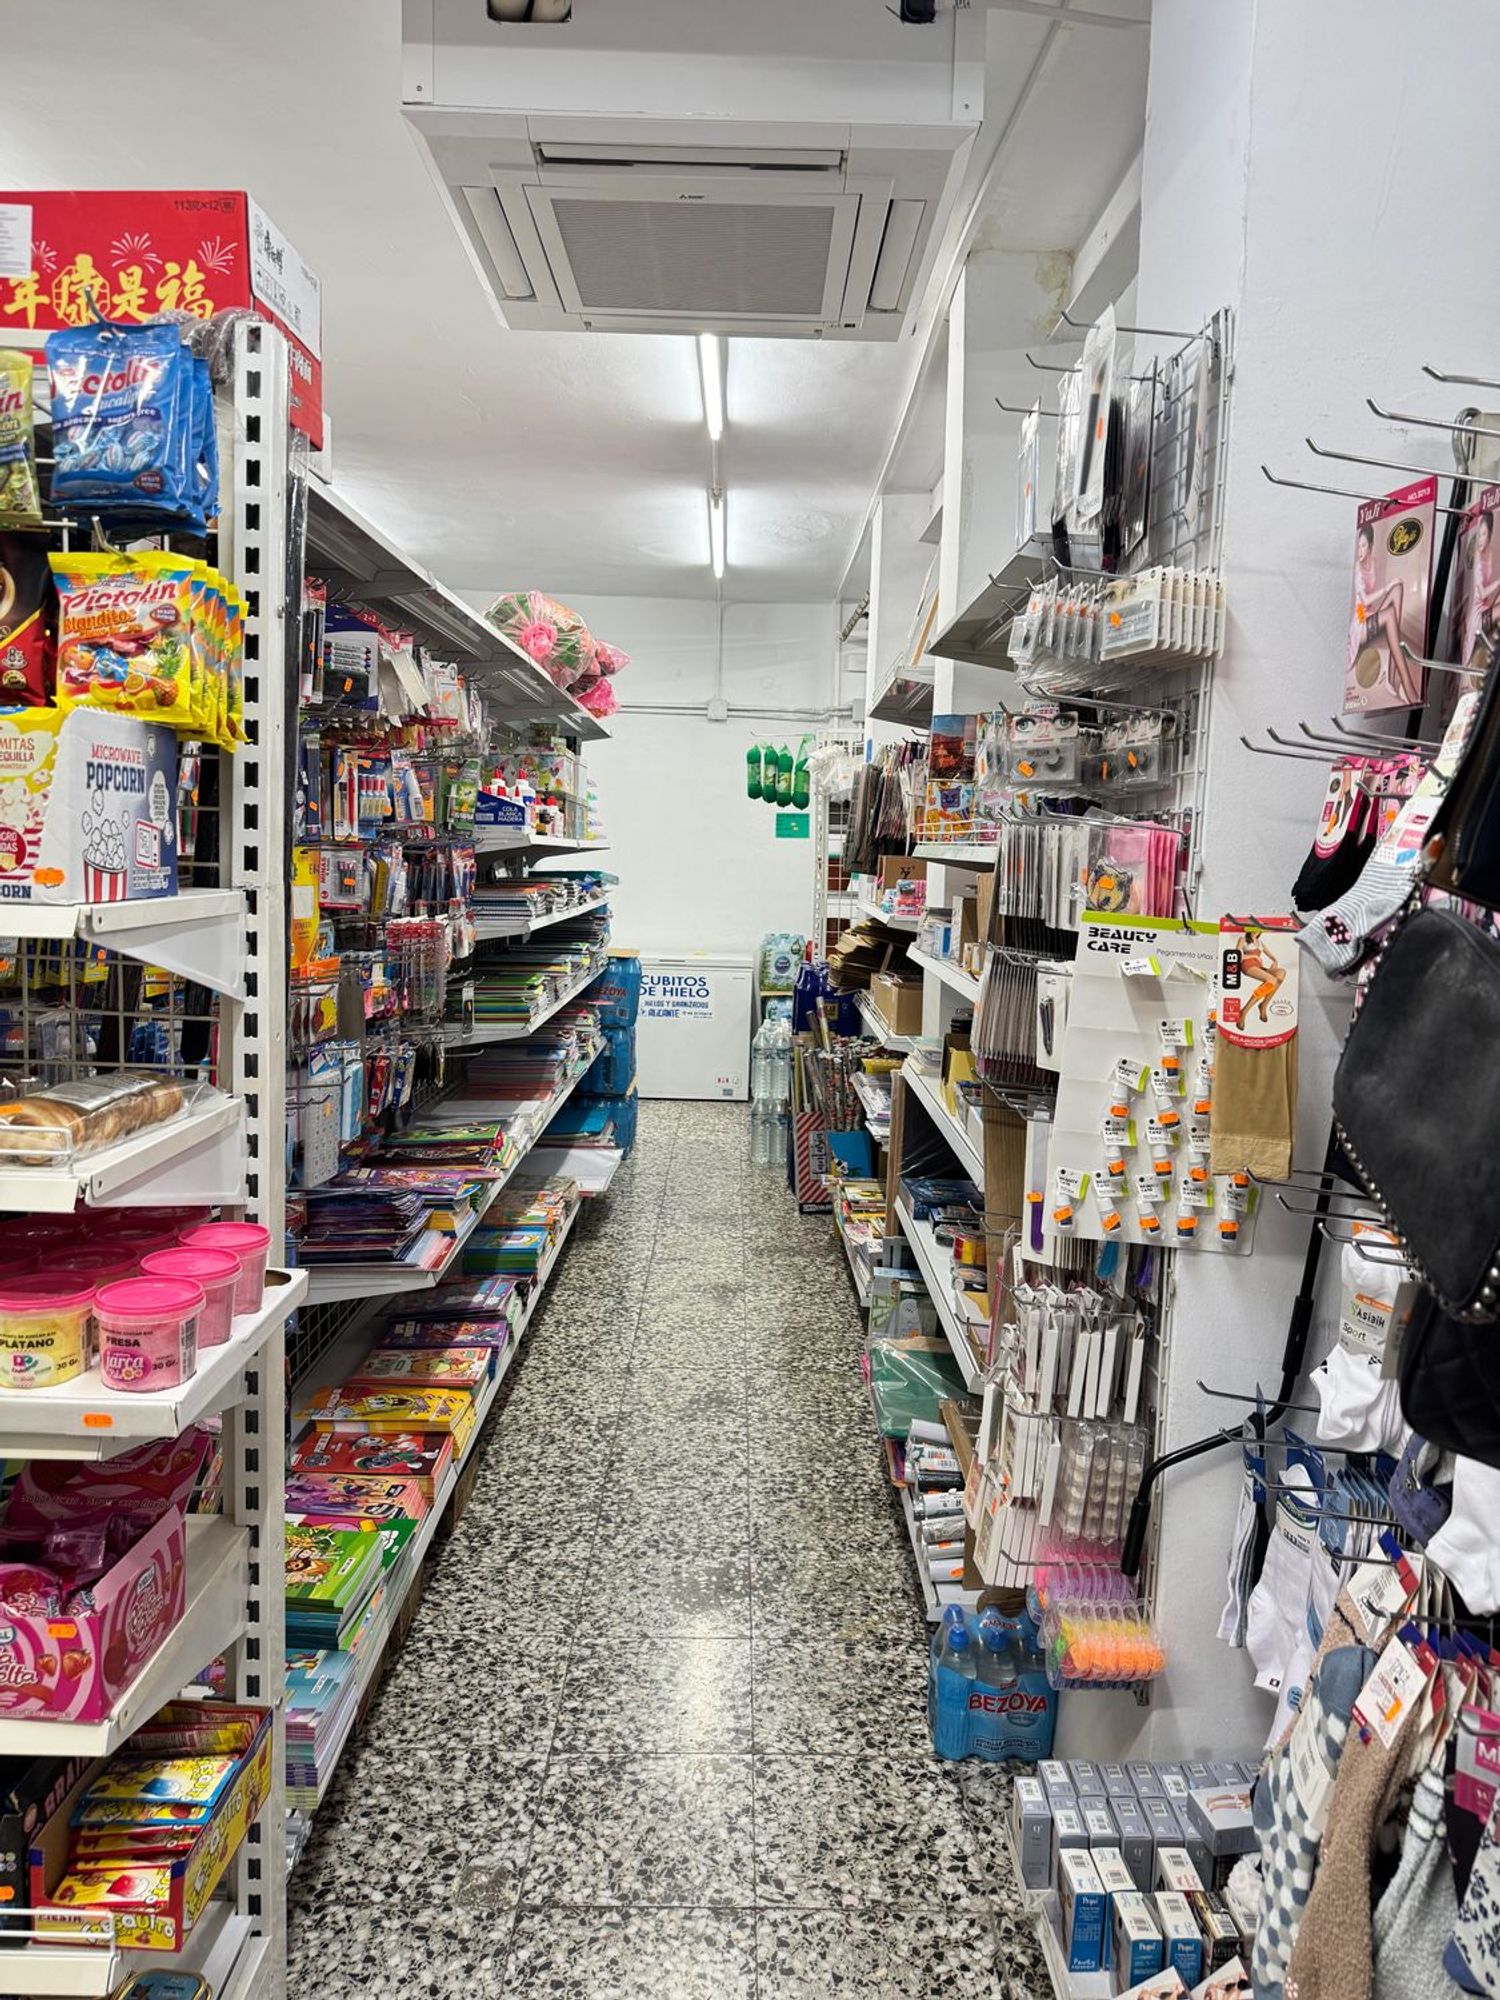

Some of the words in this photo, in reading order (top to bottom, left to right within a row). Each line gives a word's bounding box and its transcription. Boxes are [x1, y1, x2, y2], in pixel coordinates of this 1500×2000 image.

[91, 742, 143, 764] MICROWAVE
[86, 761, 146, 794] POPCORN
[0, 884, 32, 899] ORN
[1088, 926, 1157, 943] BEAUTY
[1087, 940, 1132, 954] CARE
[640, 974, 707, 987] CUBITOS
[662, 987, 710, 998] HIELO
[1343, 1322, 1367, 1341] Sport
[106, 1336, 141, 1347] FRESA
[968, 1692, 1047, 1714] BEZOYA
